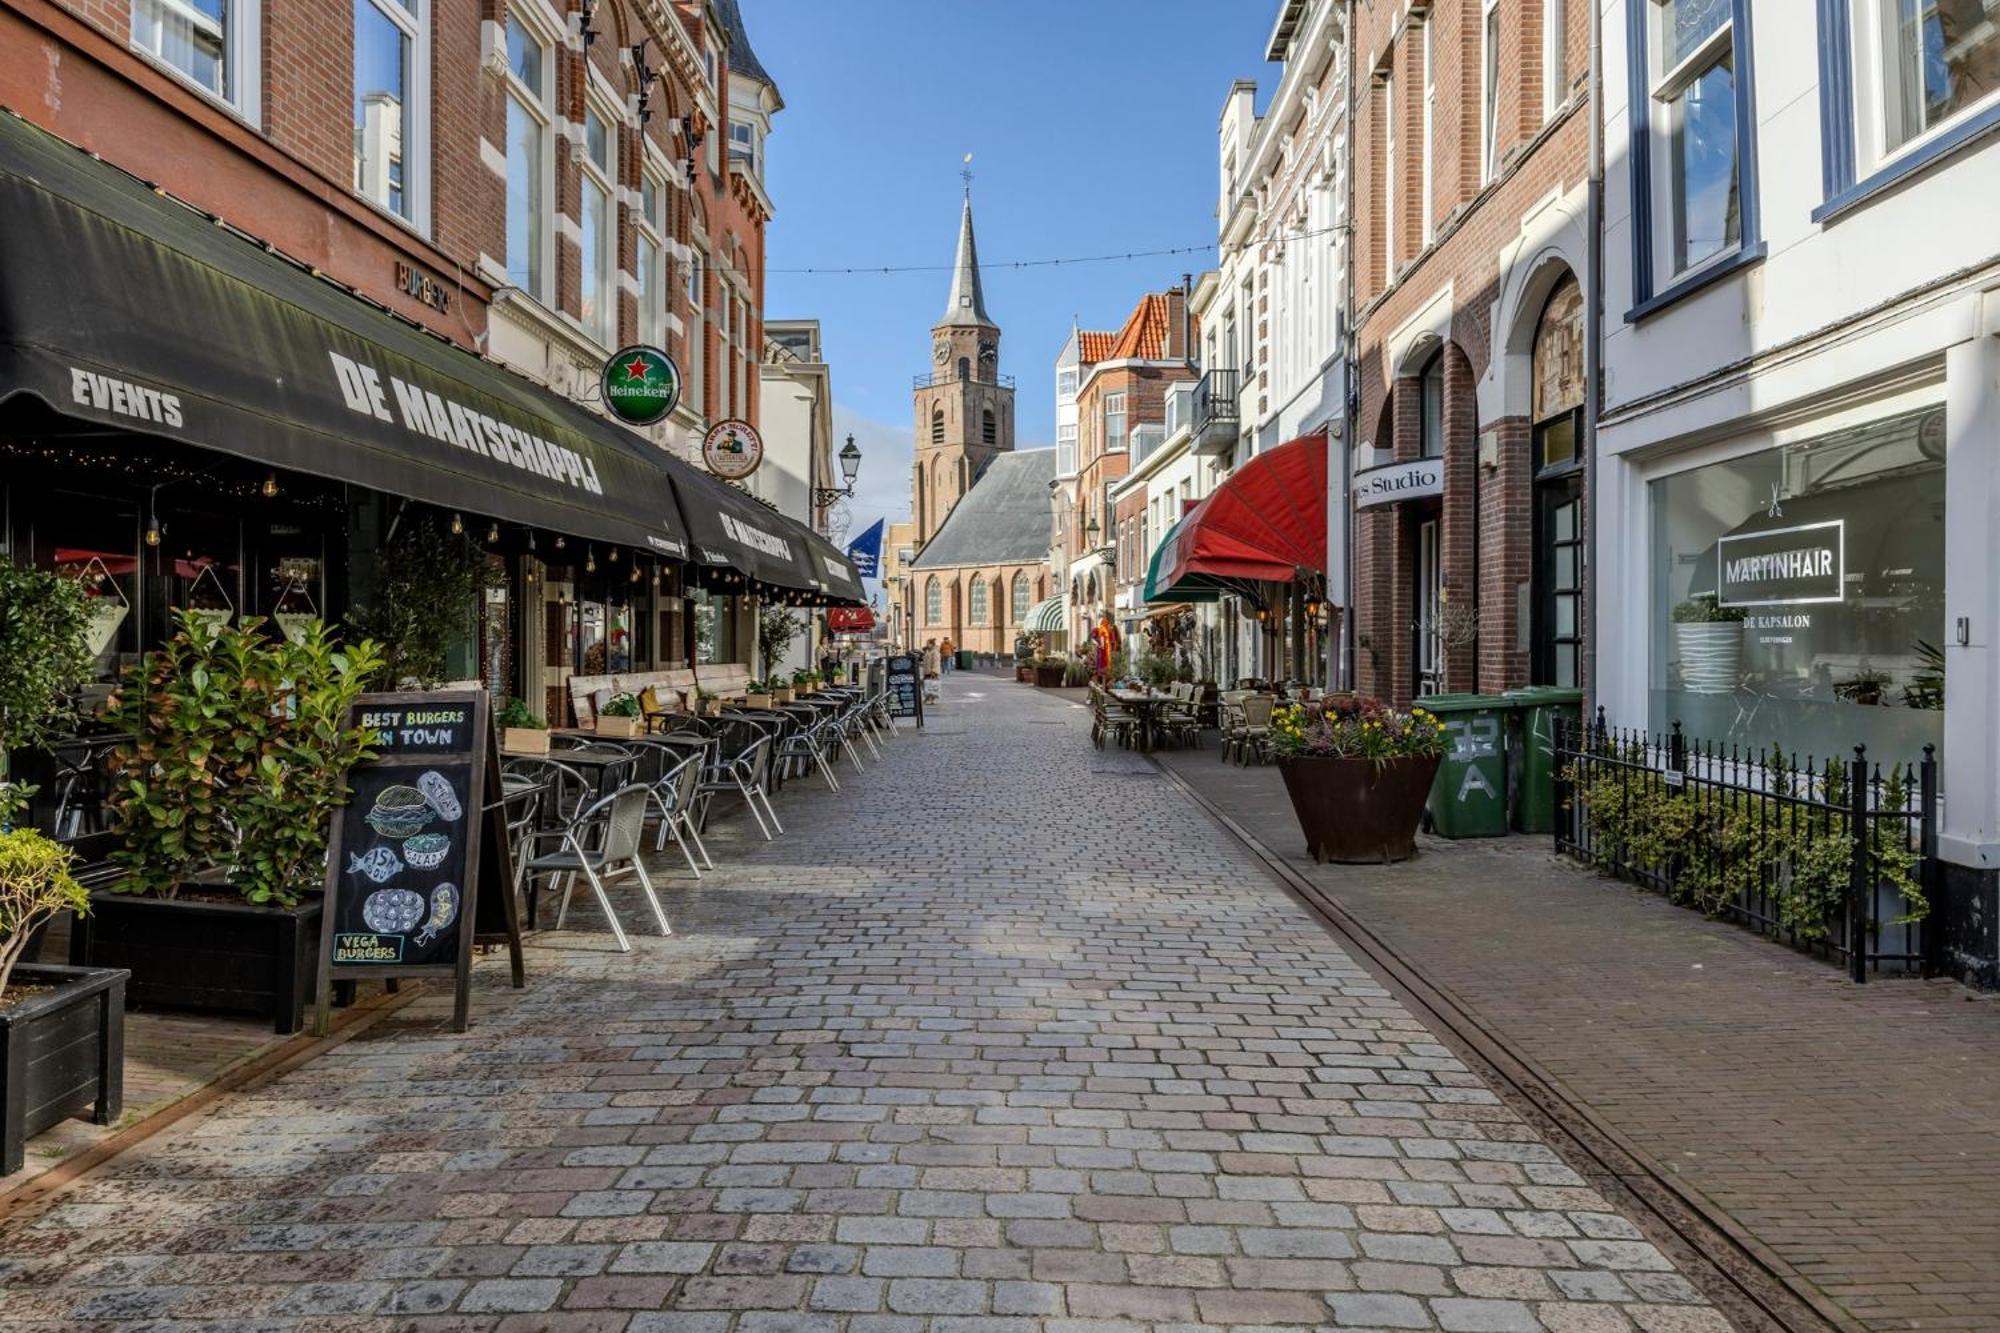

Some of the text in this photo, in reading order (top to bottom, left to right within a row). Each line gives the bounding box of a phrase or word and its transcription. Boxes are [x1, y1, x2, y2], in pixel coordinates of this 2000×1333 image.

[70, 367, 183, 428] EVENTS
[609, 384, 668, 398] Heineken
[329, 351, 603, 496] DE MAATSCHAPPIJ
[1372, 470, 1436, 495] Studio
[1726, 549, 1833, 584] MARTINHAIR
[1743, 615, 1810, 629] DE KAPSALON
[362, 711, 465, 728] BEST BURGERS
[400, 728, 453, 745] TOWN
[1457, 764, 1497, 803] A
[363, 849, 396, 869] FISH
[405, 850, 446, 866] SALADS
[342, 935, 379, 948] VEGA
[337, 947, 396, 961] BURGERS
